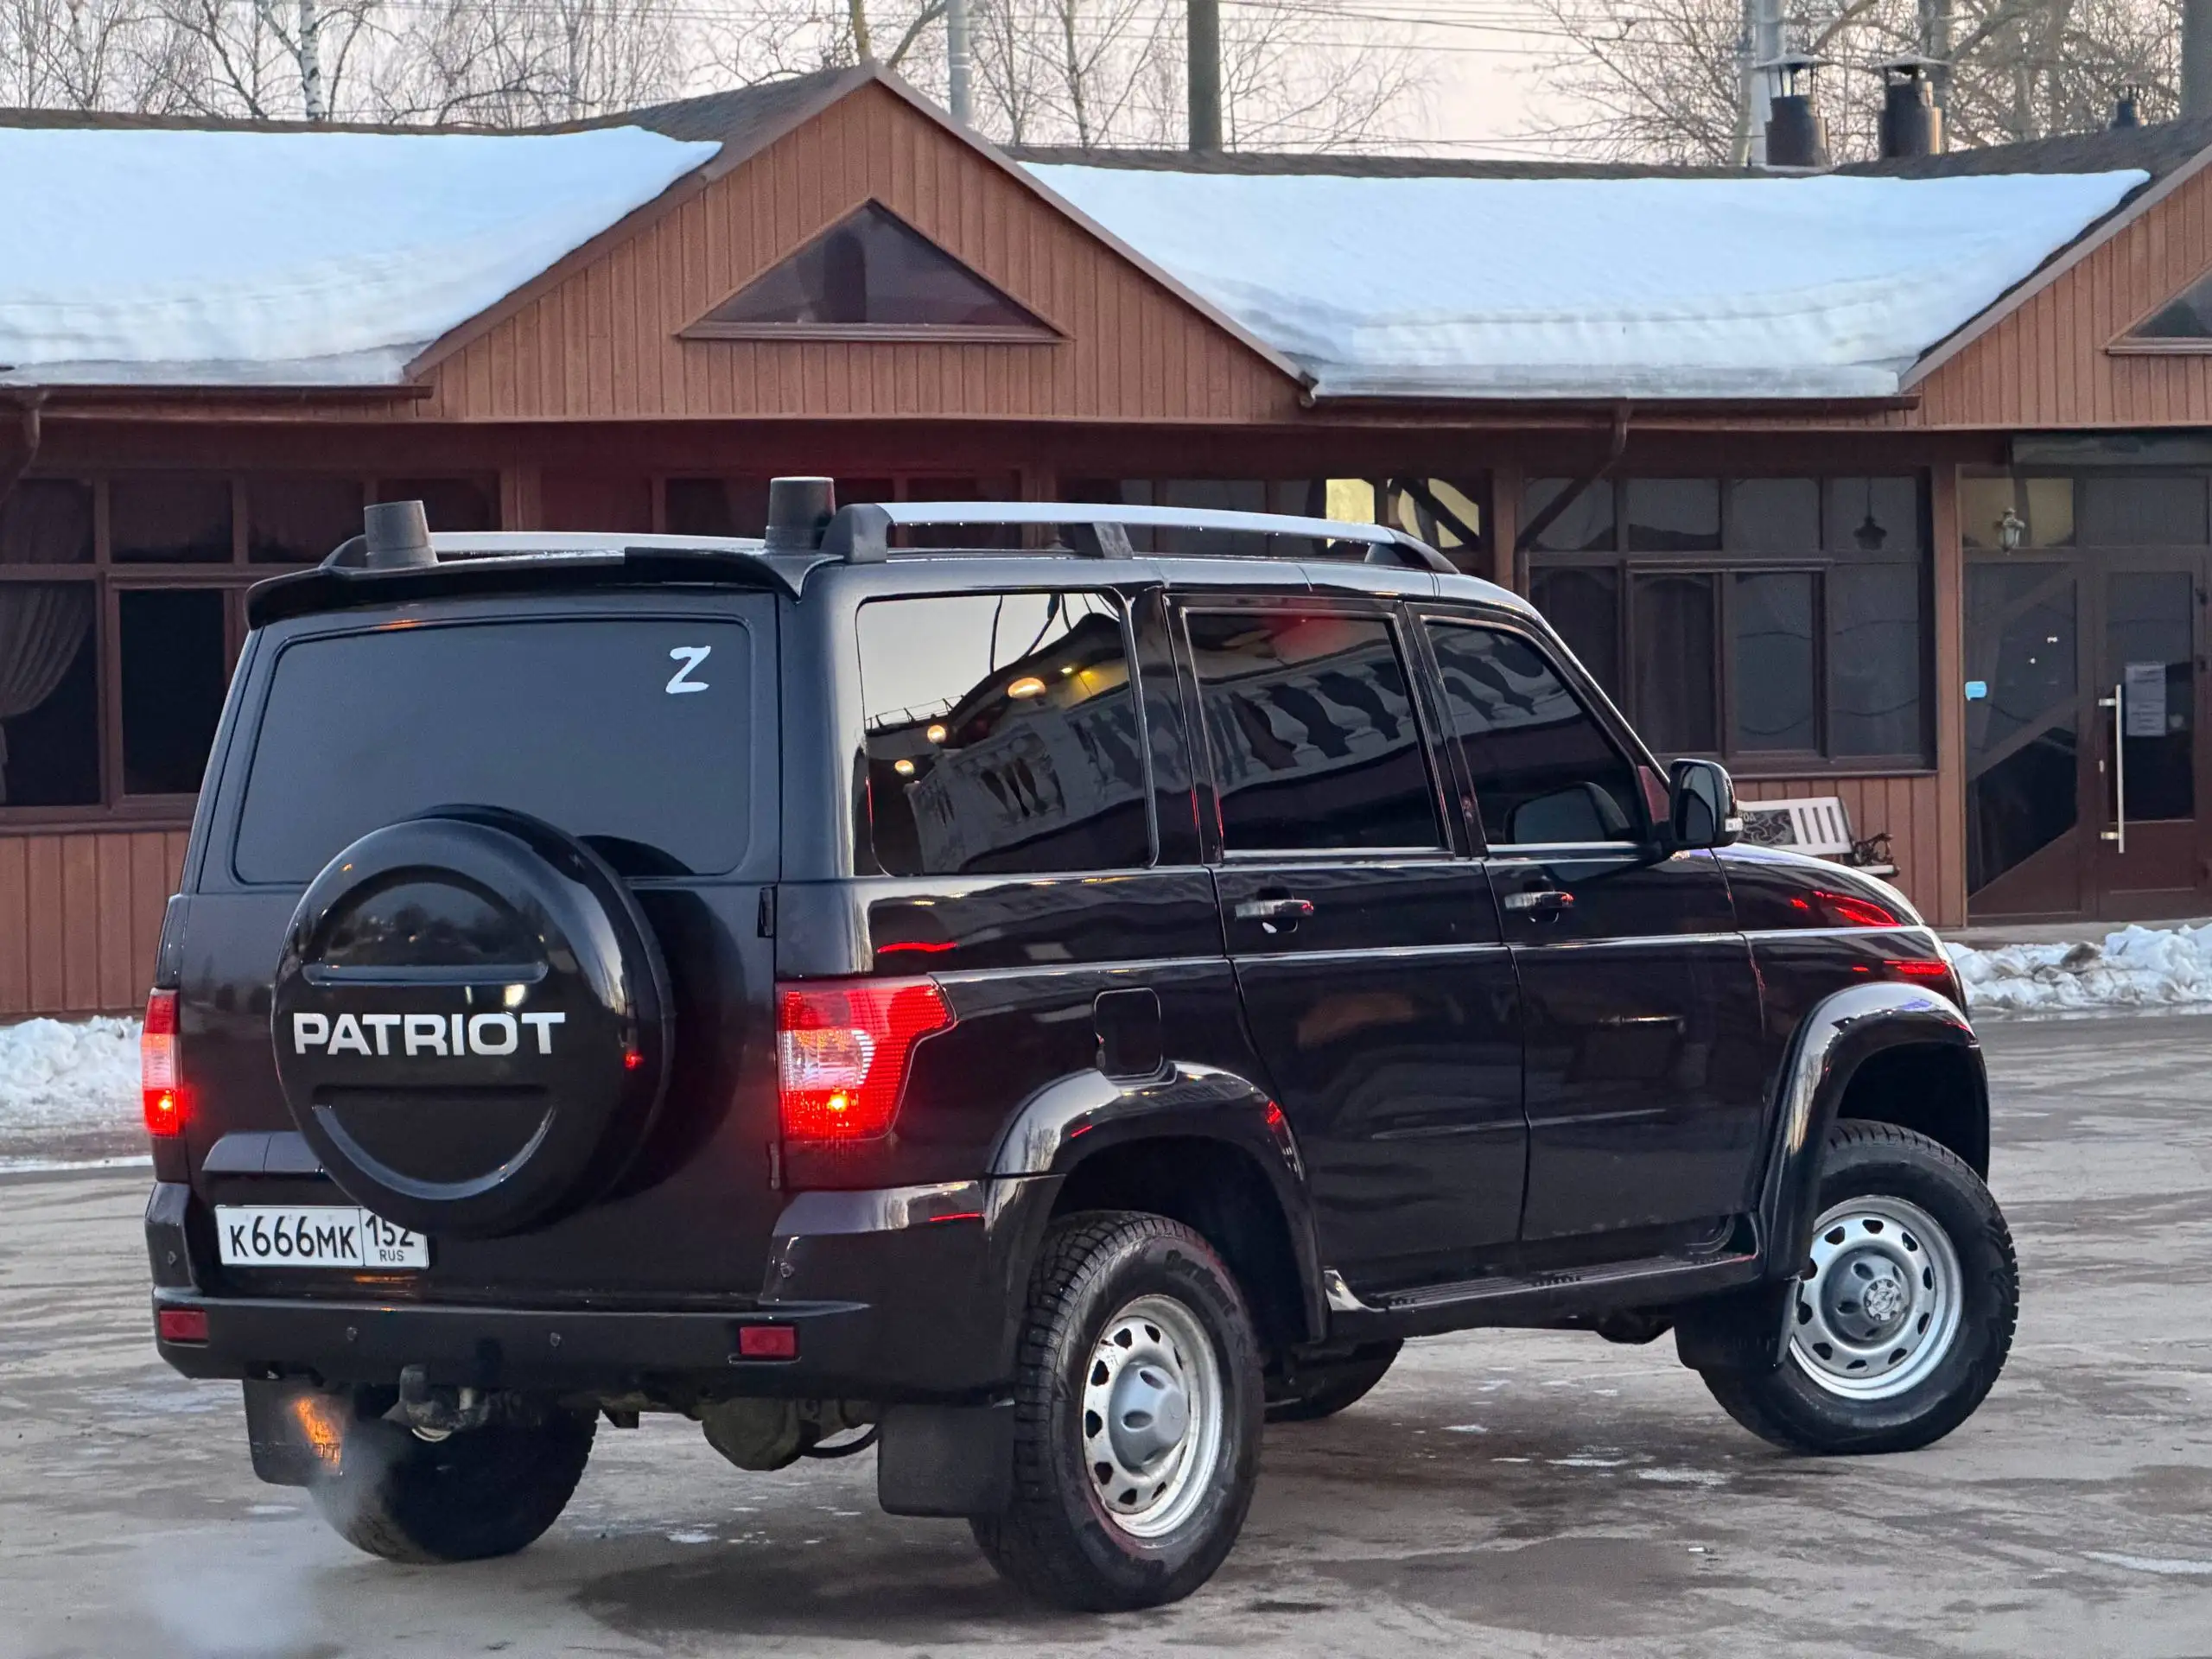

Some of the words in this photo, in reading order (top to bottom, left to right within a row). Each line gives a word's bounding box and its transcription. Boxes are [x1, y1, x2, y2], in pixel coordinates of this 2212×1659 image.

[665, 645, 711, 694] Z
[293, 1012, 566, 1056] PATRIOT
[379, 1249, 404, 1262] RUS
